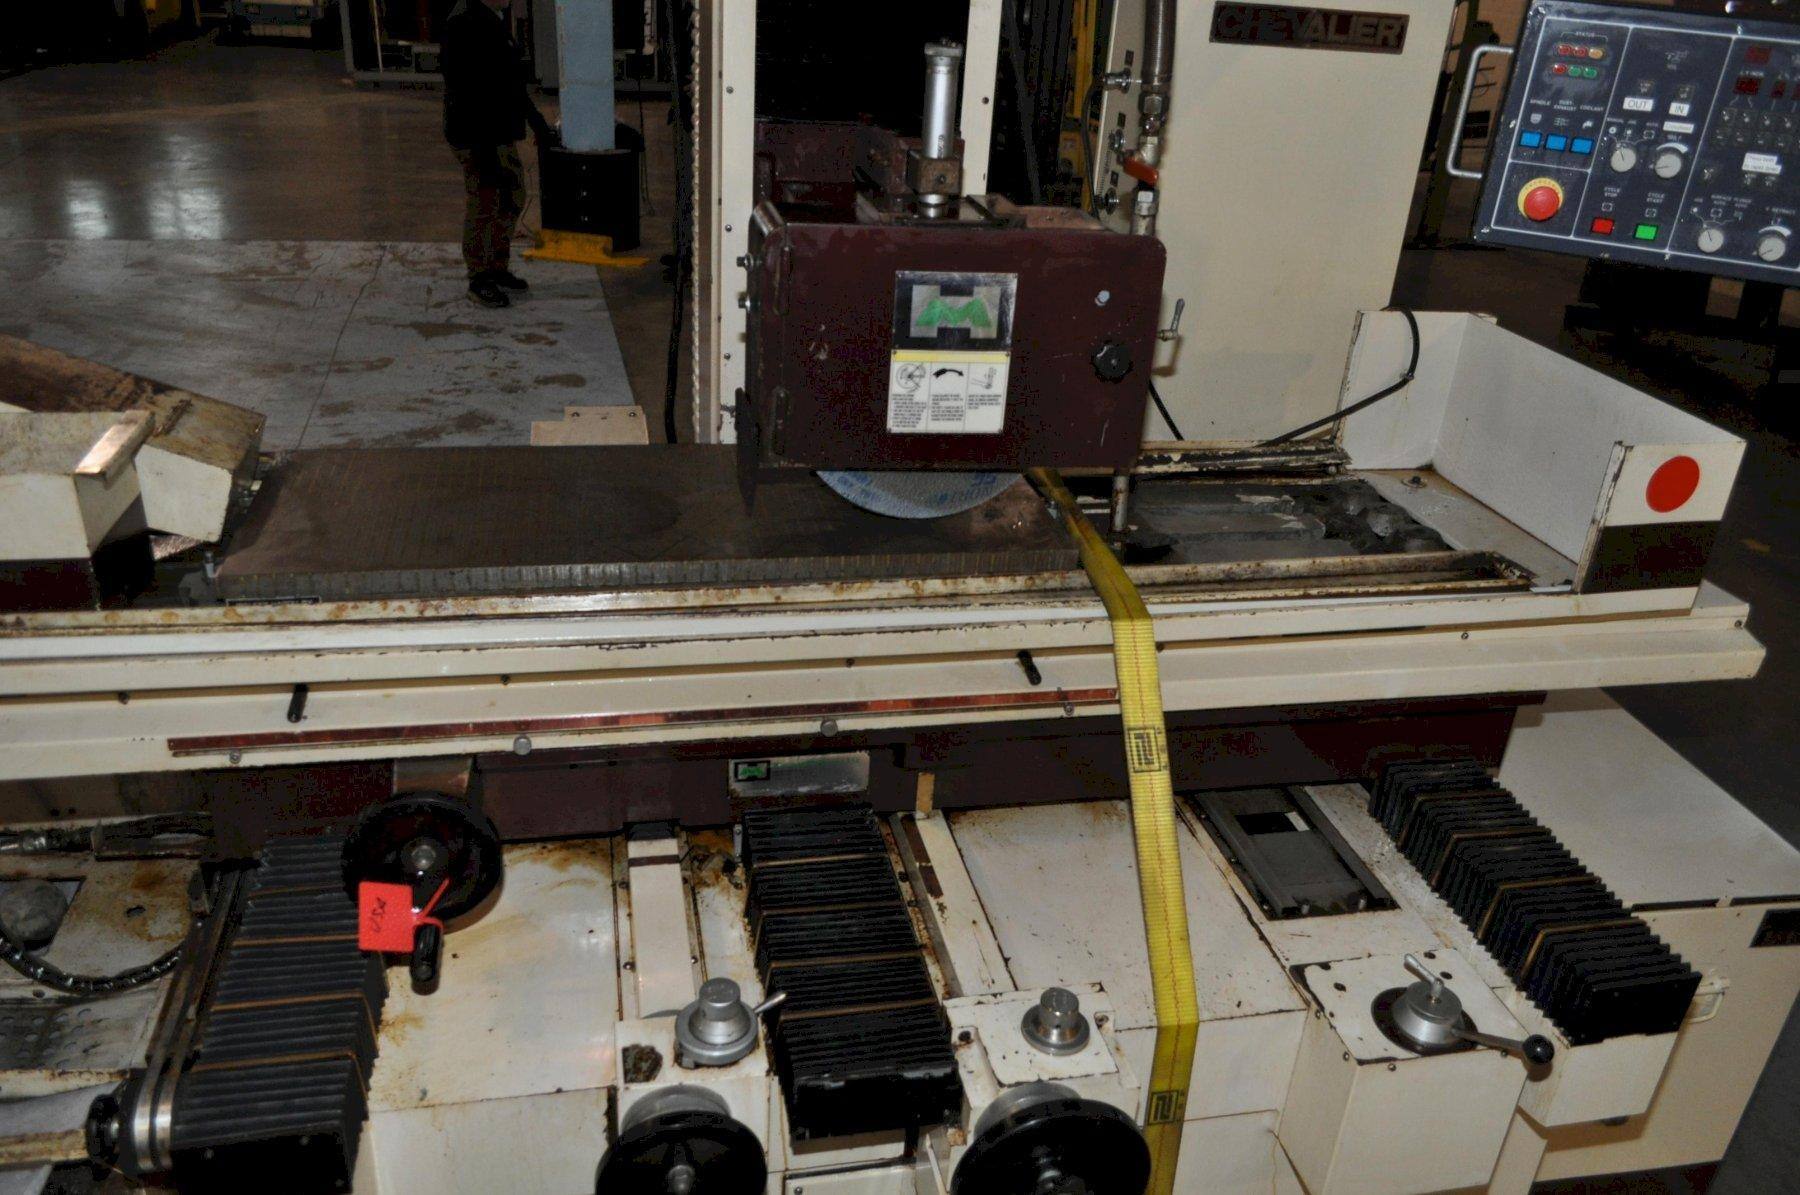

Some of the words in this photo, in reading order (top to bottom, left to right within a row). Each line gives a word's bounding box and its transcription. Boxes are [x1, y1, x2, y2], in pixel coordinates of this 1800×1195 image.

[1217, 4, 1401, 46] CHEVALIER
[1627, 100, 1648, 109] OUT
[1674, 105, 1685, 114] IN
